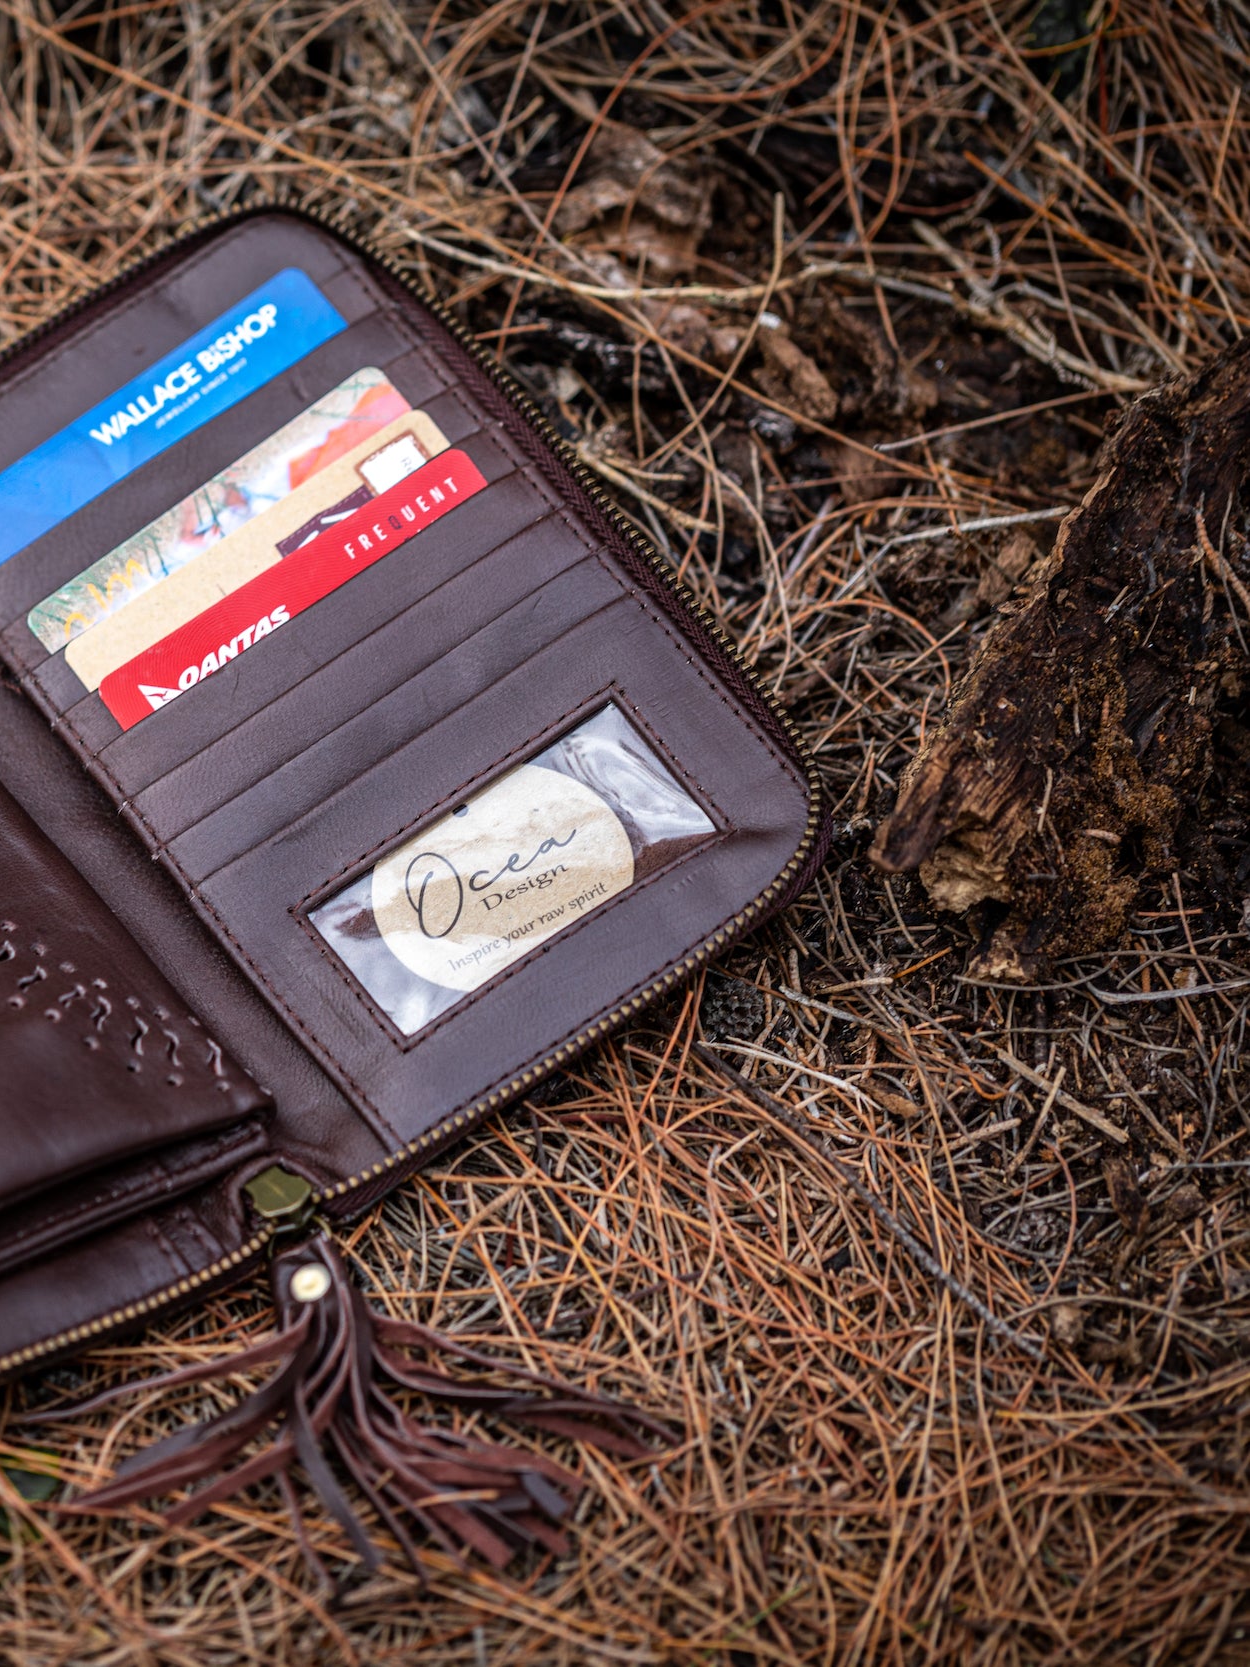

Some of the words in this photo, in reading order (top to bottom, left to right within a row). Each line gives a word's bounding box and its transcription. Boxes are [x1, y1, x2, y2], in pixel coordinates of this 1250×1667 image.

[90, 361, 202, 445] WALLACE
[344, 477, 458, 559] FREQUENT
[405, 829, 576, 938] Ocea
[479, 864, 569, 911] Design
[448, 939, 502, 971] Inspire
[502, 920, 536, 949] your
[538, 904, 565, 926] raw
[569, 882, 609, 911] spirit
